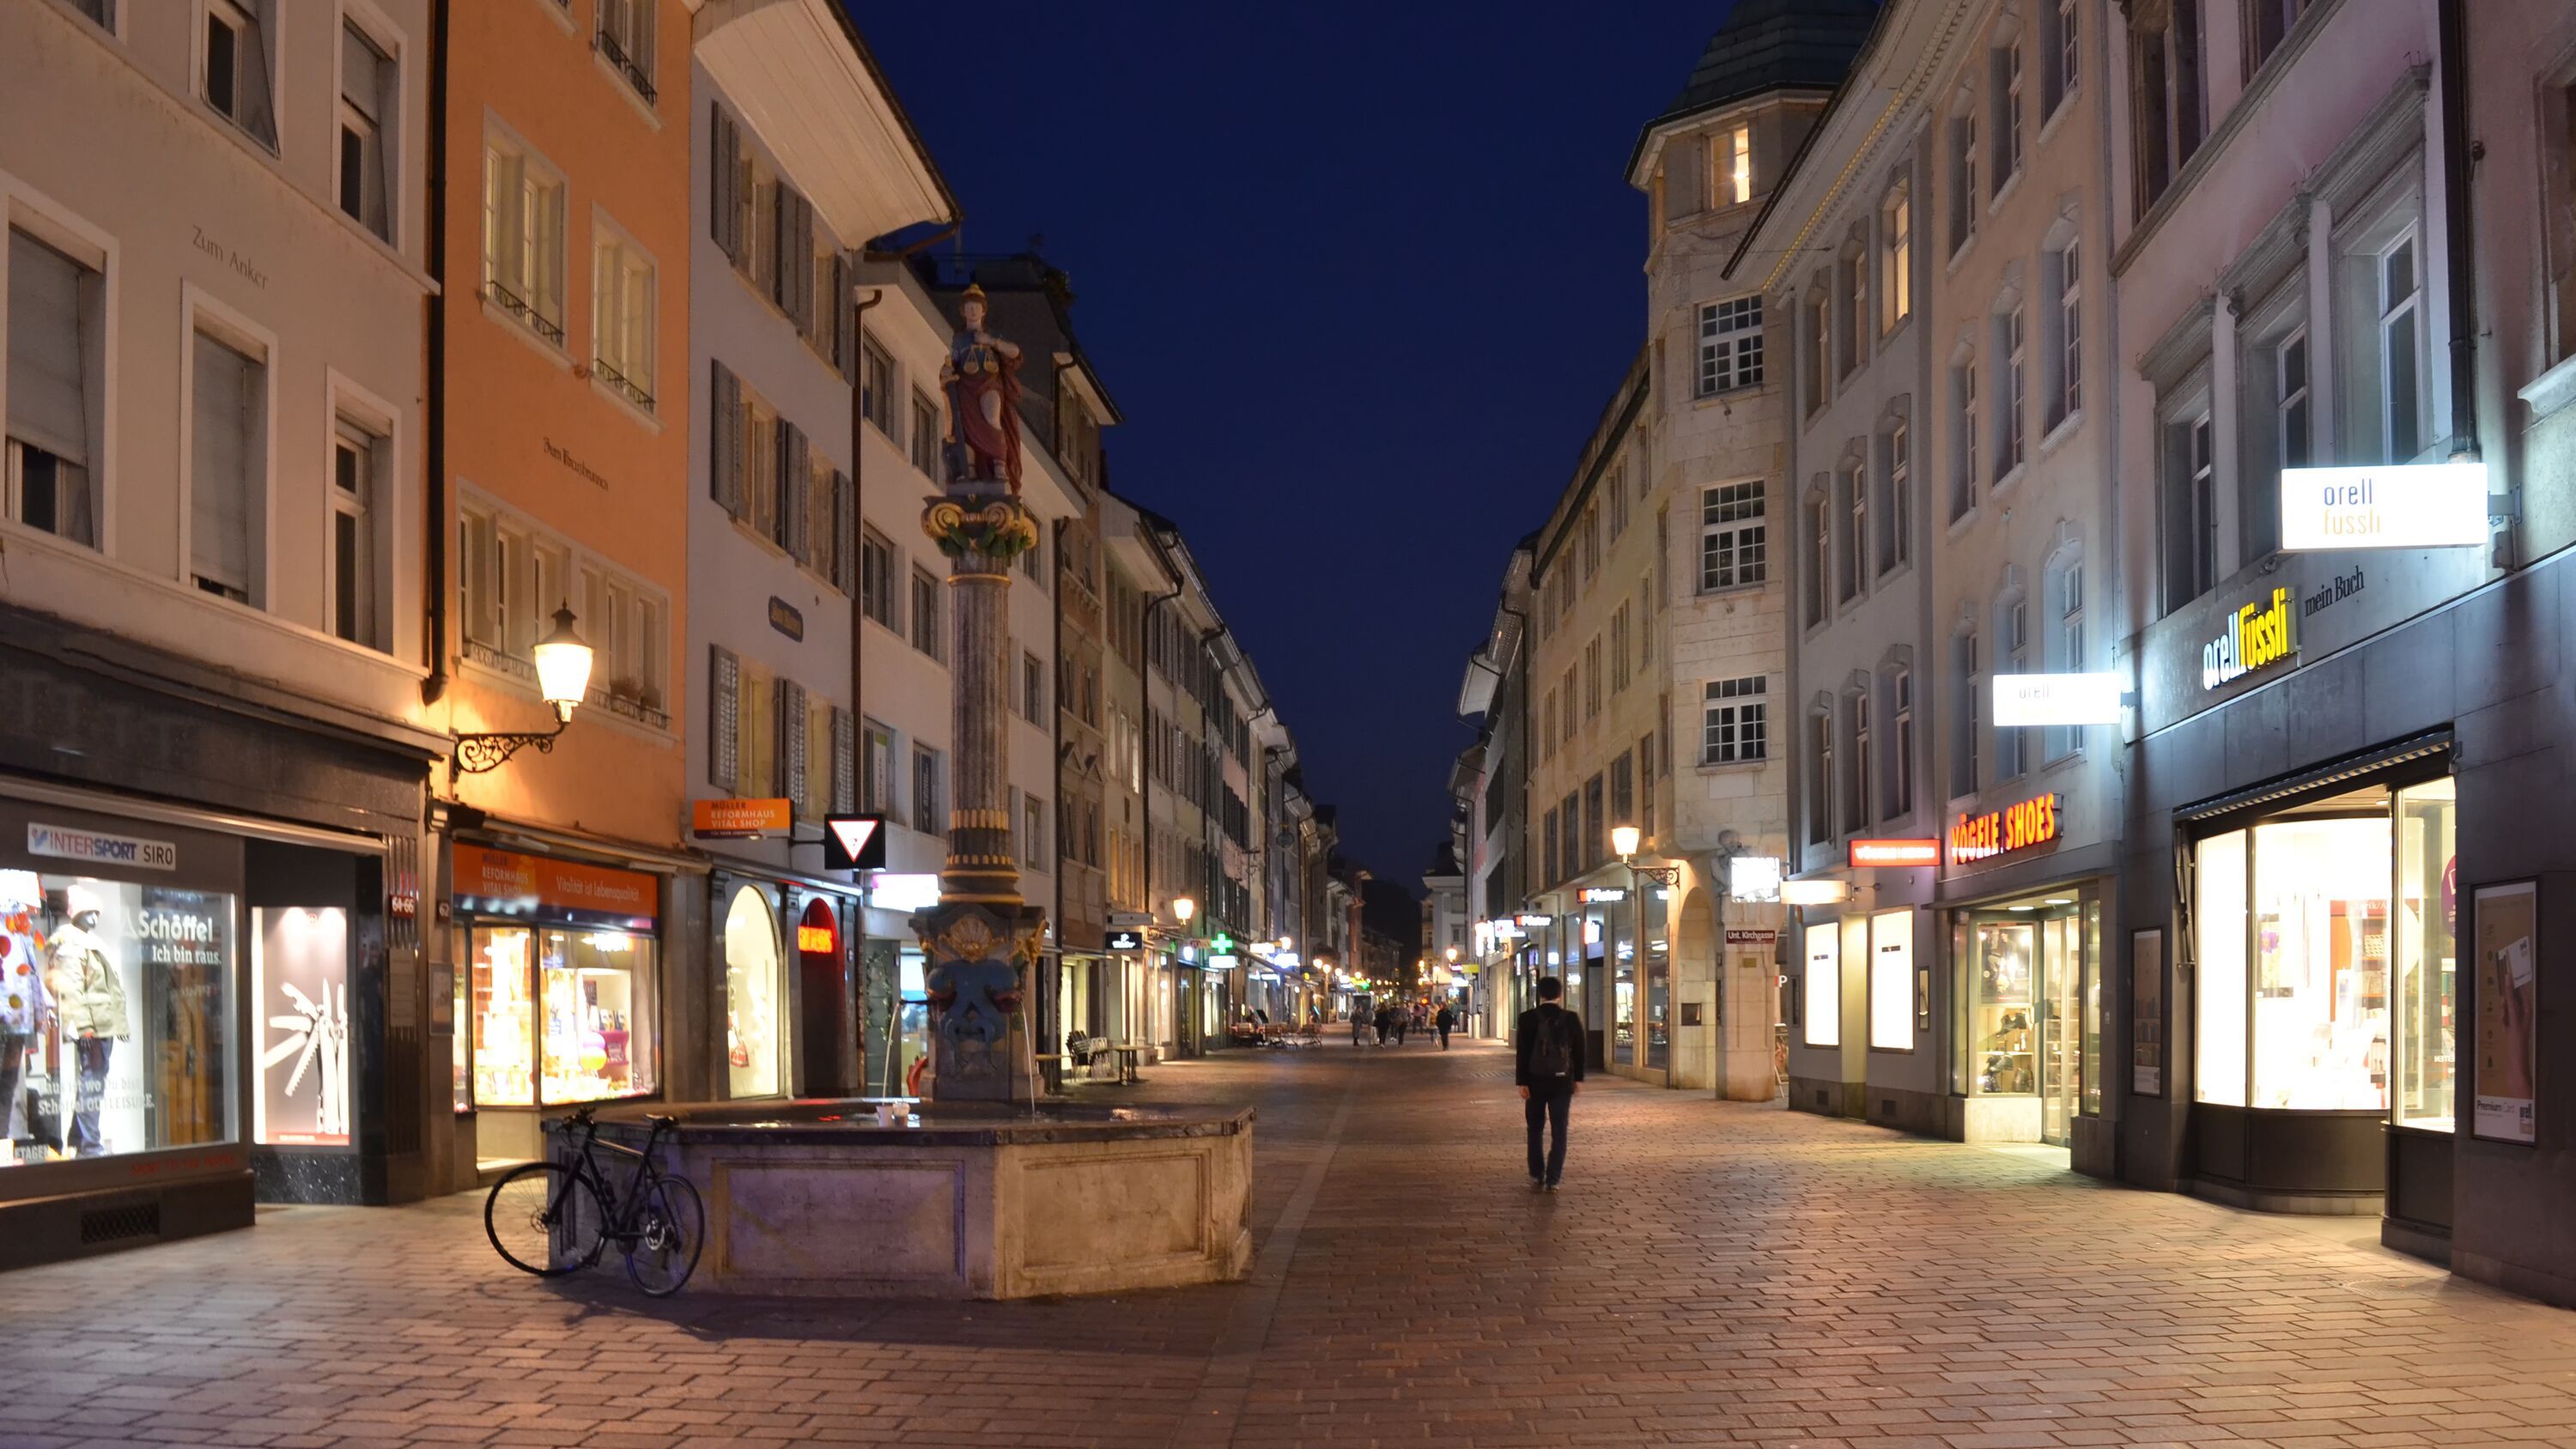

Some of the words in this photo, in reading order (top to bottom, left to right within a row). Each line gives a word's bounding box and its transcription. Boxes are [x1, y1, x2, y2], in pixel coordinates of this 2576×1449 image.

[192, 224, 223, 262] Zum
[229, 251, 268, 290] Anker
[2324, 478, 2372, 506] orell
[2305, 585, 2334, 617] mein
[2335, 565, 2365, 603] Buch
[710, 809, 775, 819] REFORMHAUS
[739, 819, 767, 828] SHOP
[1951, 811, 2000, 866] VÖGELE
[2005, 791, 2055, 851] SHOES
[50, 830, 137, 860] INTERSPORT
[143, 844, 173, 865] SIRO
[482, 866, 529, 884] REFORMHAUS
[482, 881, 501, 895] VITAL
[137, 910, 213, 943] Schöffel
[1728, 931, 1741, 939] Unt.
[1741, 931, 1774, 942] Kirchgasse
[152, 943, 171, 962] Ich
[173, 944, 193, 963] bin
[195, 949, 222, 965] raus.
